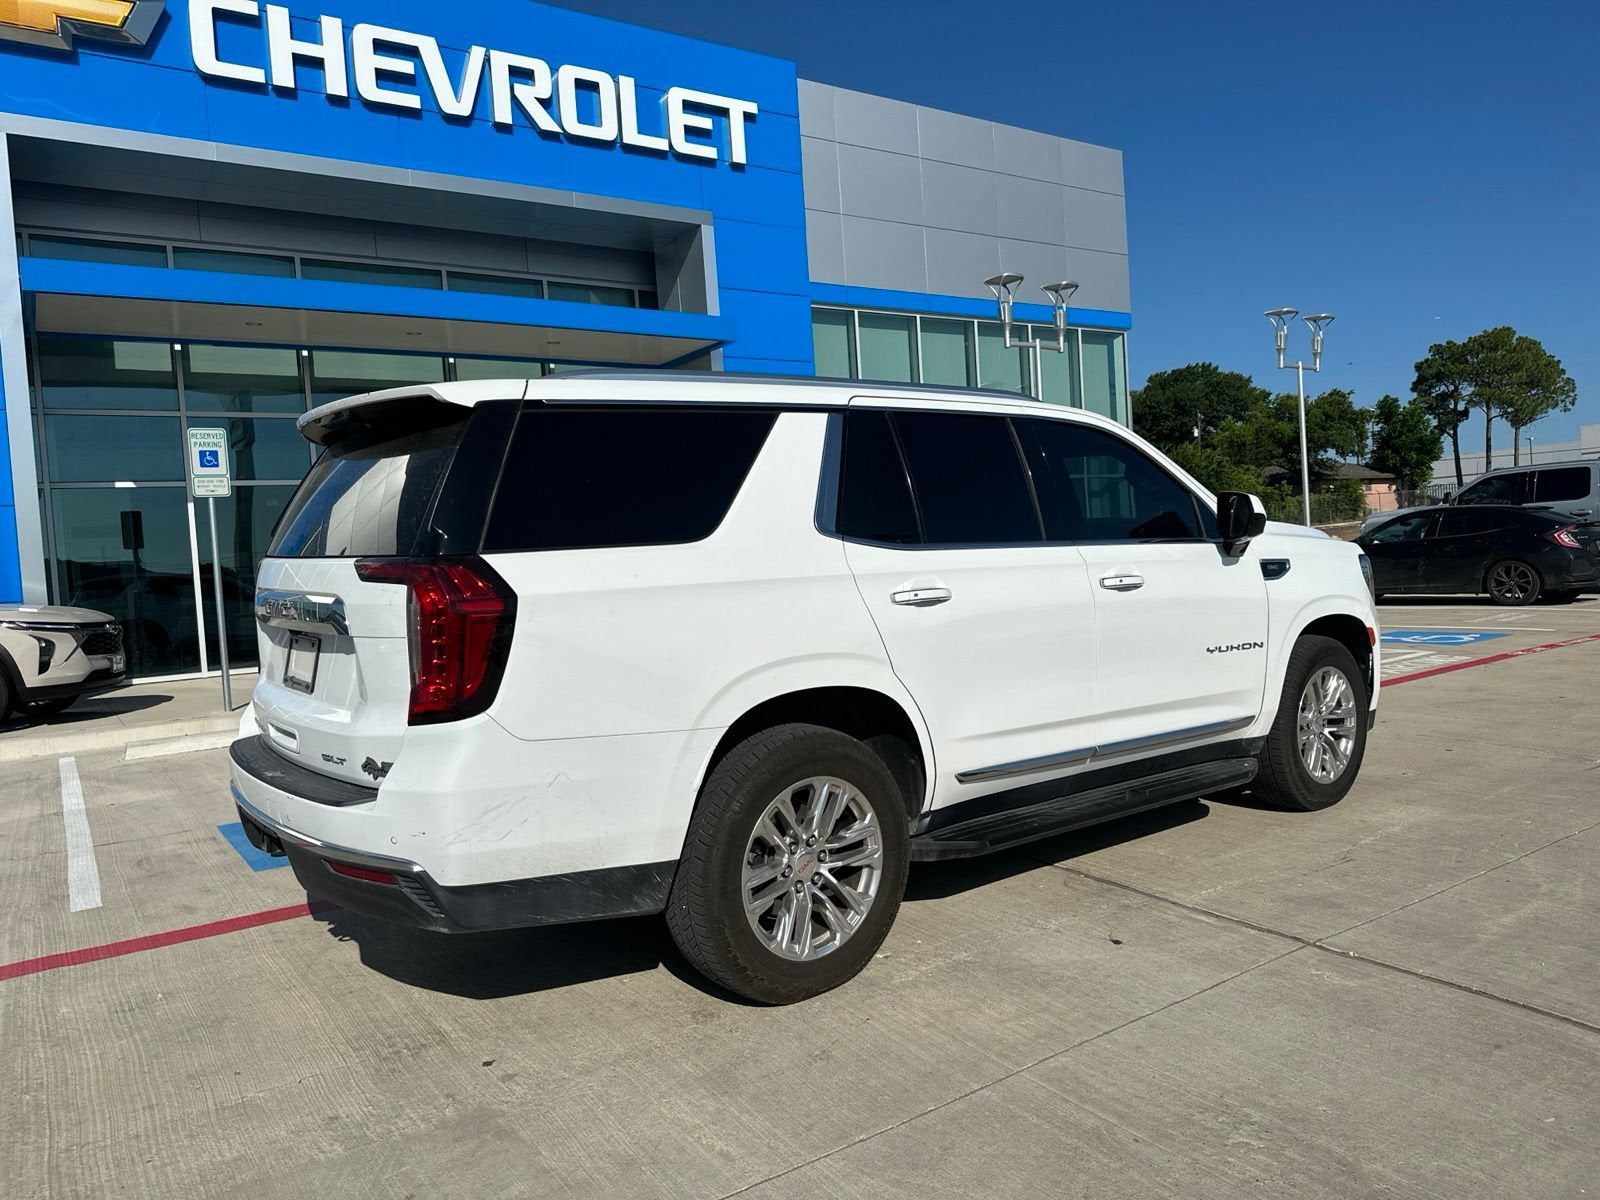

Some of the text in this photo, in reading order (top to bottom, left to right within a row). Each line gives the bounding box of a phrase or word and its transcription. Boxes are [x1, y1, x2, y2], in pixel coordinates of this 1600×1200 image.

[189, 0, 758, 165] CHEVROLET
[190, 432, 224, 440] RESERVED
[1206, 642, 1264, 654] YUKON
[321, 753, 346, 766] SLT
